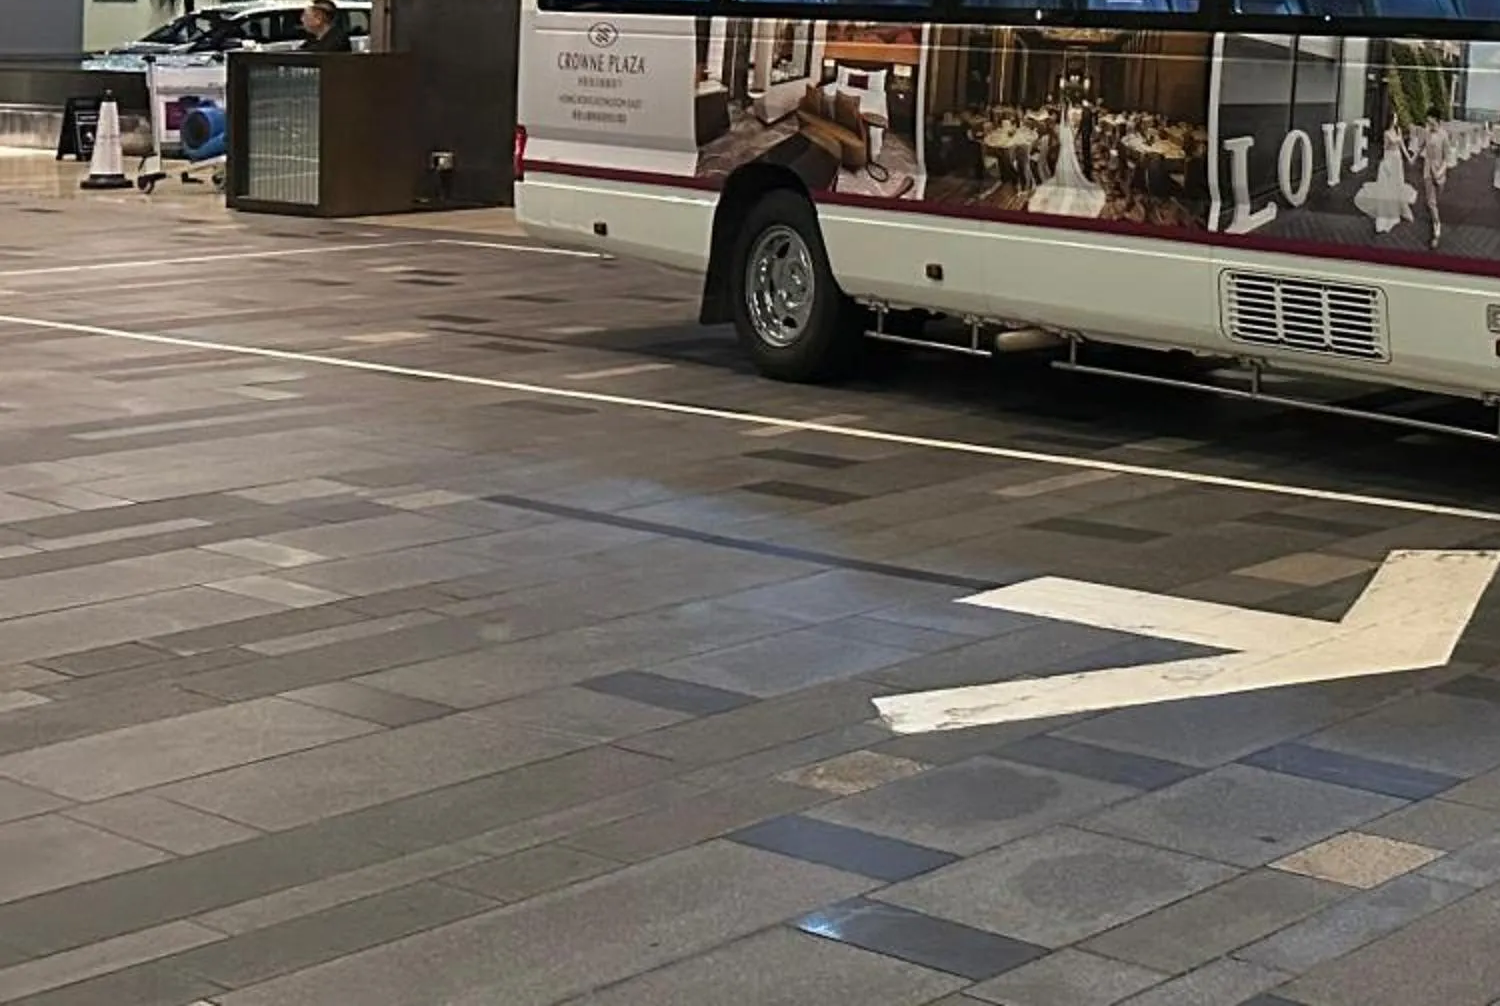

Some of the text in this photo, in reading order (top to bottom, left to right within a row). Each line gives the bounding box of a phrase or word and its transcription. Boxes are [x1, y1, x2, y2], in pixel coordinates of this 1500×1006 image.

[557, 51, 646, 75] CROWNE PLAZA
[1223, 117, 1371, 235] LOVE
